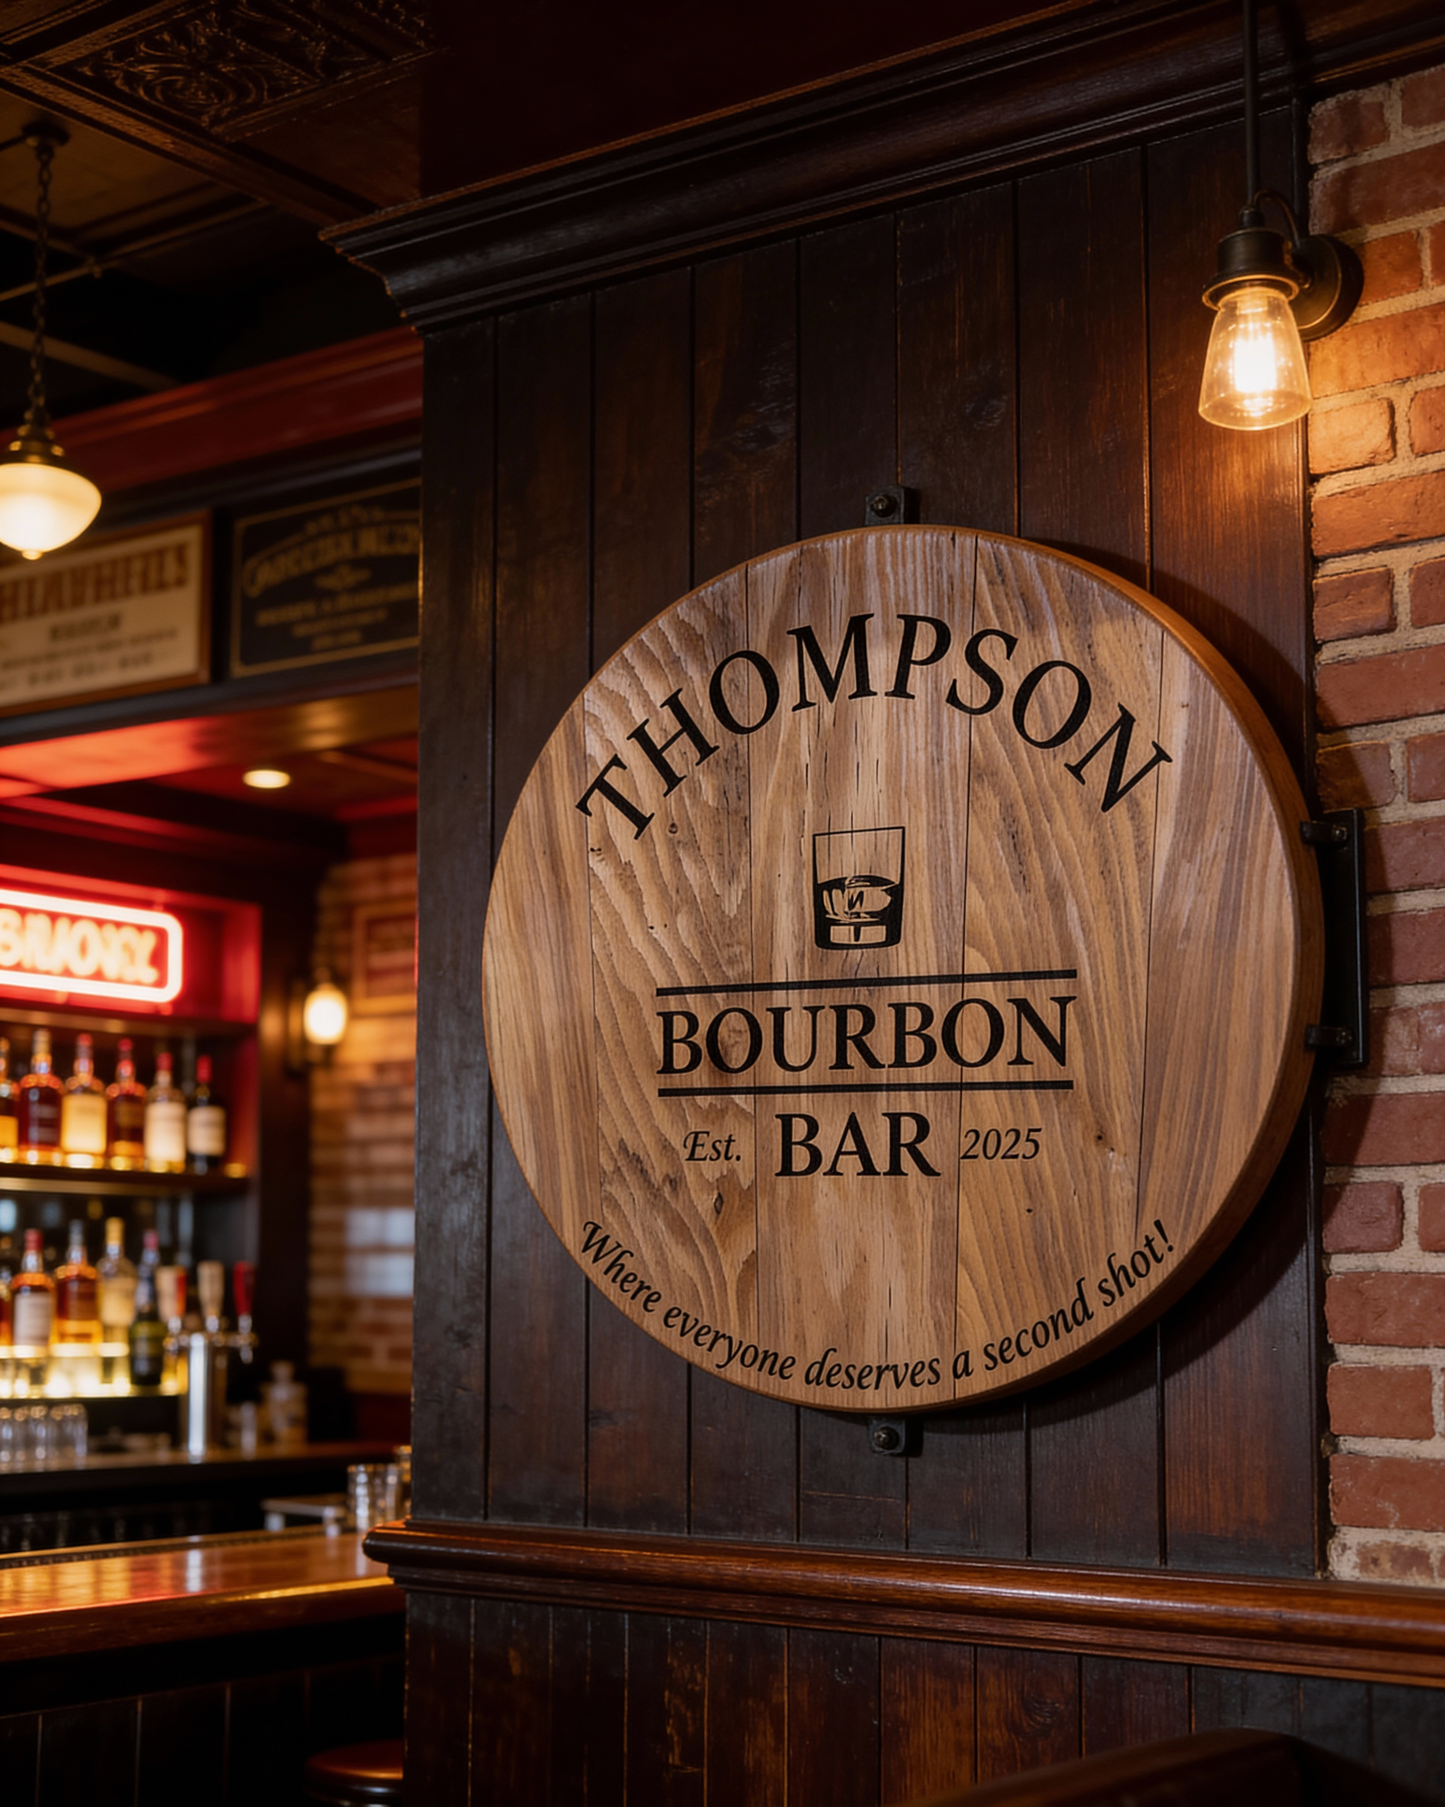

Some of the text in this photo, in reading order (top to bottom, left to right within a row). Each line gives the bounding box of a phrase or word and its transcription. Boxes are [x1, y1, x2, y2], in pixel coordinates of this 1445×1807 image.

[575, 613, 1173, 840] THOMPSON
[656, 996, 1077, 1075] BOURBON
[683, 1111, 1042, 1178] Est. BAR 2025
[581, 1219, 1174, 1390] Where everyone deserves a second shot!
